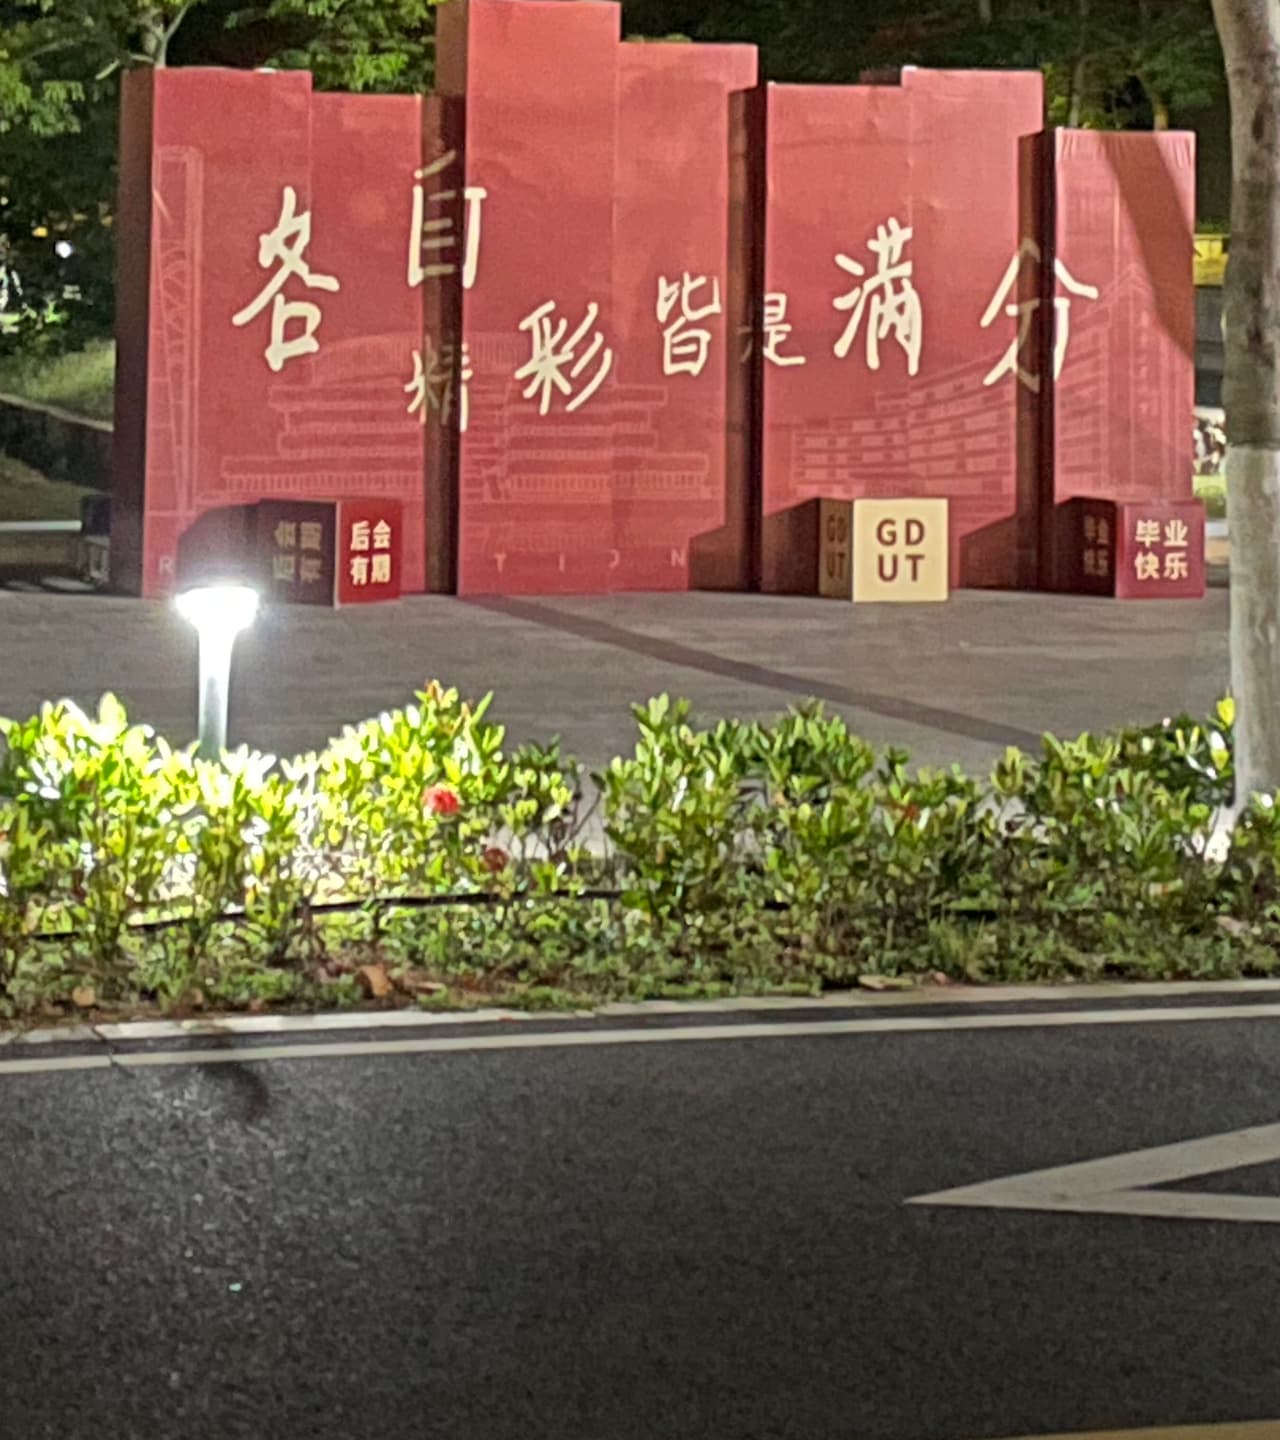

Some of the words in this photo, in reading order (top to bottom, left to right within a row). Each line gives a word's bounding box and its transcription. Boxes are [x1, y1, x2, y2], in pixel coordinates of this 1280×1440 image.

[350, 519, 392, 551] 后会
[876, 517, 926, 547] GD
[1135, 519, 1189, 548] 毕业
[350, 553, 392, 586] 有期
[877, 554, 926, 582] UT
[1134, 551, 1189, 580] 快乐
